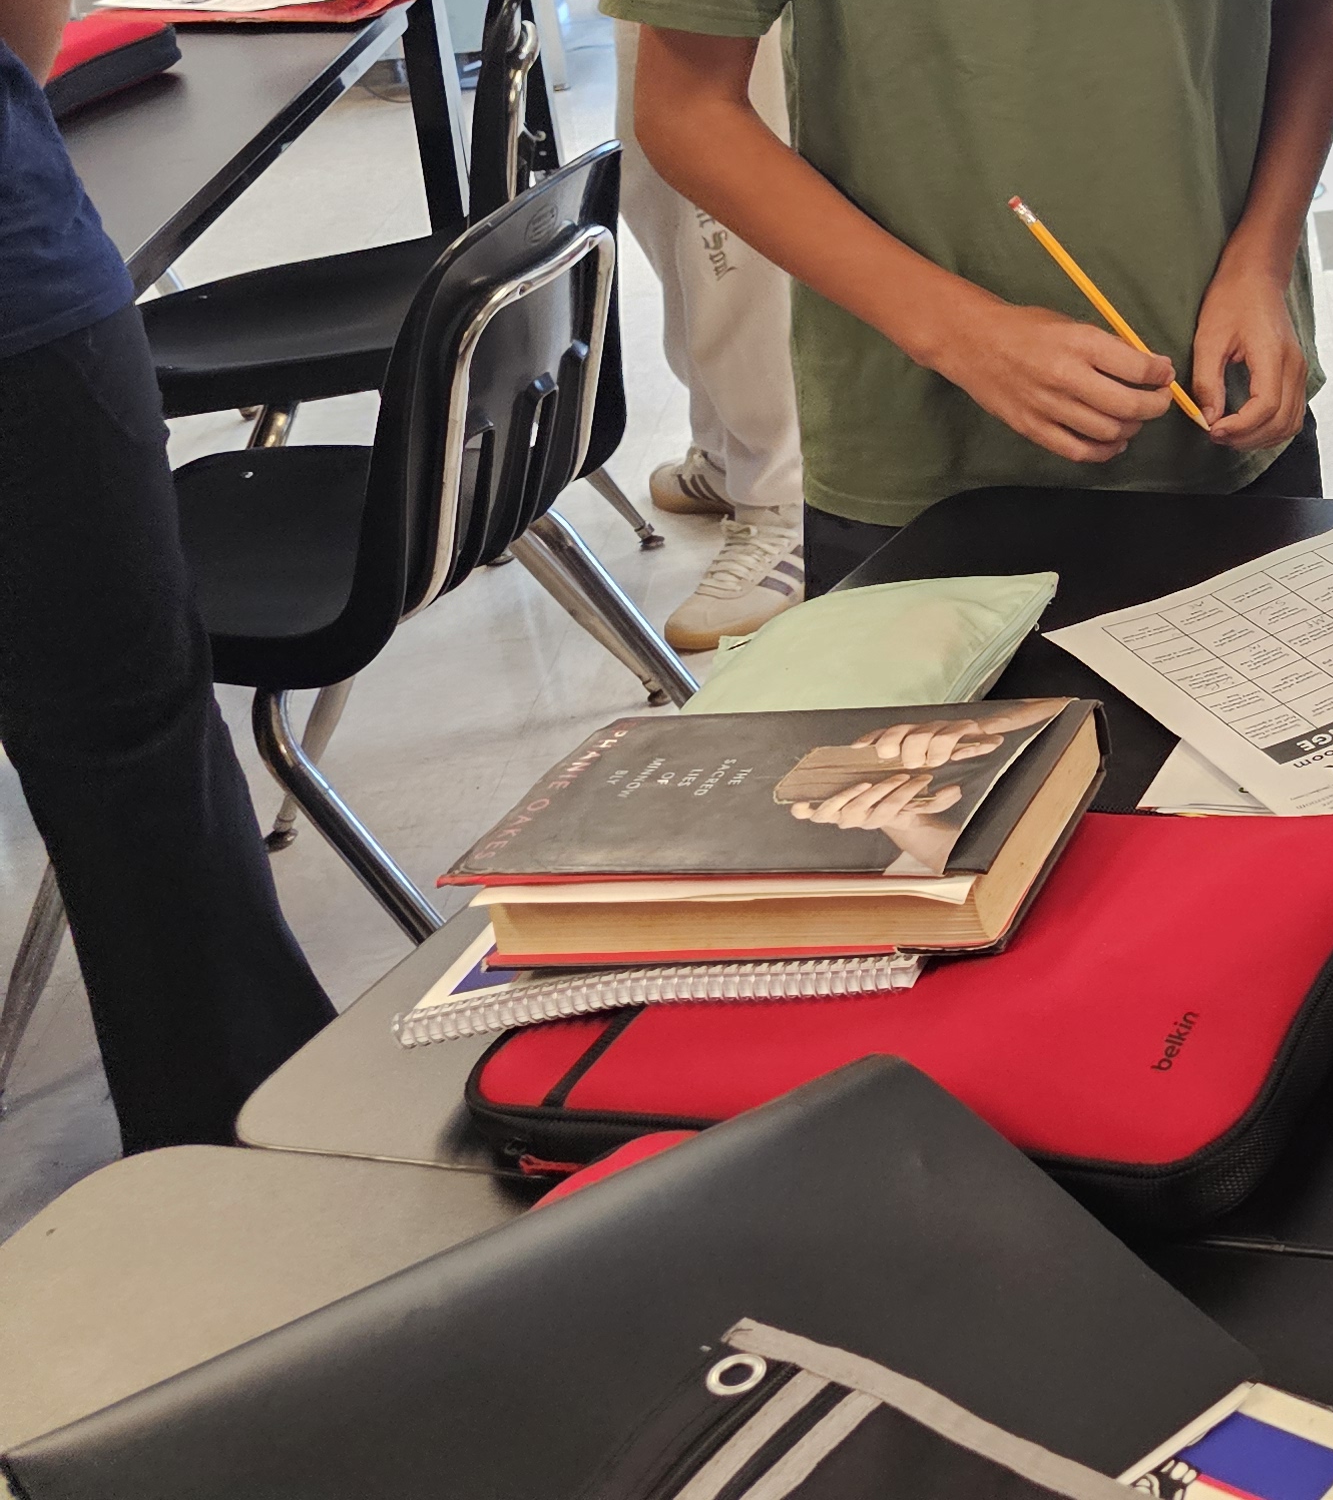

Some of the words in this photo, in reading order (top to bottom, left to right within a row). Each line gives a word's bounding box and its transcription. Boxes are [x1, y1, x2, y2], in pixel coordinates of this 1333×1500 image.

[606, 769, 628, 786] BLY
[617, 757, 666, 799] MINNOW
[657, 771, 675, 785] OF
[677, 768, 703, 787] LIES
[694, 758, 737, 797] SACRED
[728, 767, 752, 786] THE
[474, 798, 550, 860] OAKES
[1151, 1011, 1199, 1073] belkin
